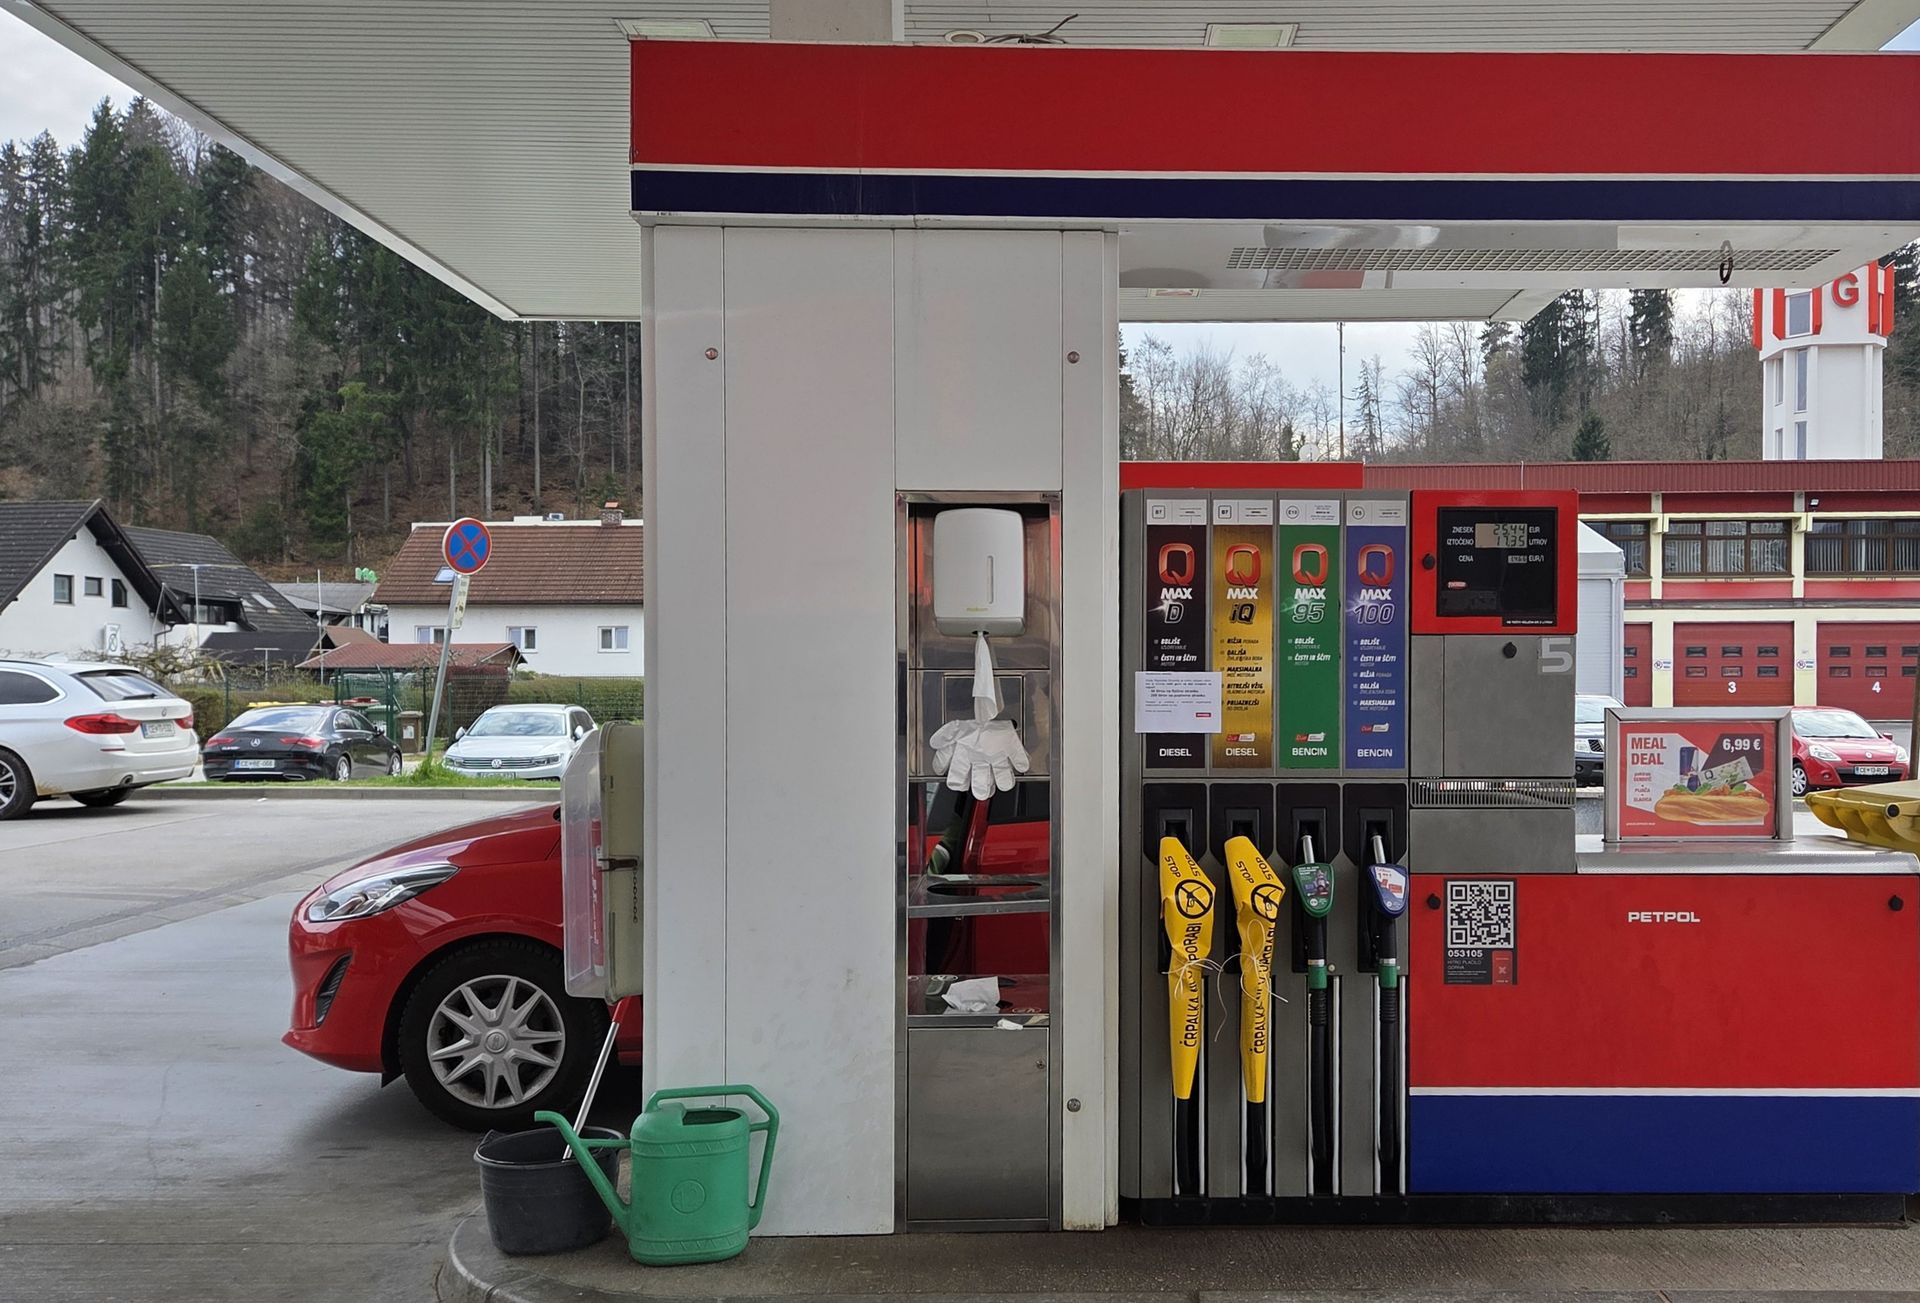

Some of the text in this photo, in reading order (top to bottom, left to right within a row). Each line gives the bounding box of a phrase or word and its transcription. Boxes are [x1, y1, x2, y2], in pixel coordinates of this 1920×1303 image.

[1832, 272, 1859, 308] G
[1159, 543, 1195, 586] Q
[1225, 543, 1261, 587] Q
[1292, 543, 1328, 587] Q
[1358, 544, 1394, 587] Q
[1161, 588, 1192, 599] MAX
[1227, 588, 1258, 599] MAX
[1294, 588, 1326, 600] MAX
[1360, 589, 1392, 600] MAX
[1164, 602, 1184, 623] D
[1292, 602, 1325, 623] 95
[1354, 603, 1395, 624] 100
[1542, 638, 1573, 672] 5
[1728, 681, 1737, 693] 3
[1872, 681, 1881, 693] 4
[1631, 737, 1667, 749] MEAL
[1722, 738, 1761, 752] 6,99 €
[1160, 748, 1192, 757] DIESEL
[1226, 748, 1258, 756] DIESEL
[1292, 748, 1328, 756] BENCIN
[1357, 749, 1392, 757] BENCIN
[1631, 753, 1664, 765] DEAL
[1164, 855, 1181, 878] STOP
[1185, 854, 1200, 877] STOP
[1235, 860, 1254, 884] STOP
[1255, 856, 1273, 880] STOP
[1448, 949, 1483, 958] 053105
[1179, 997, 1199, 1047] ČRPALKA
